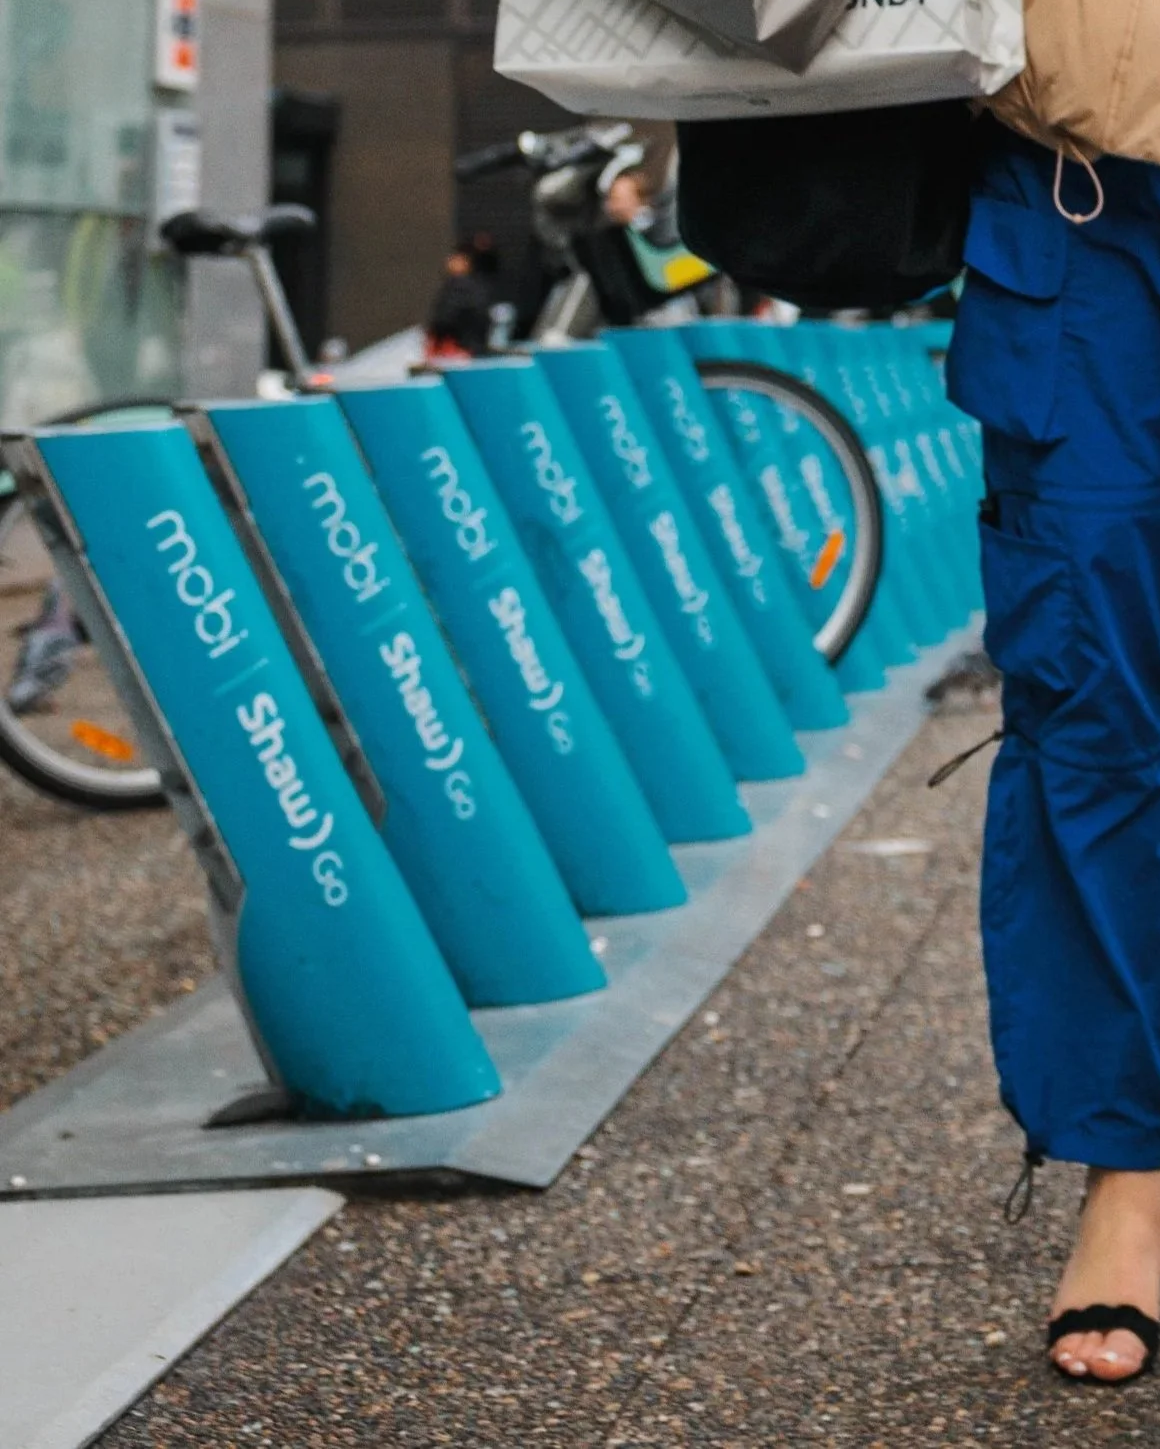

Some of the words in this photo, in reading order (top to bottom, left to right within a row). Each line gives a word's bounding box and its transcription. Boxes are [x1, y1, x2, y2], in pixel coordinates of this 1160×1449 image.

[146, 509, 249, 659] mobi
[236, 692, 325, 840] Shaw
[311, 850, 349, 907] Go
[302, 470, 391, 603] mobi
[378, 631, 456, 762] Shaw
[420, 445, 499, 562] mobi
[488, 586, 558, 703] Shaw
